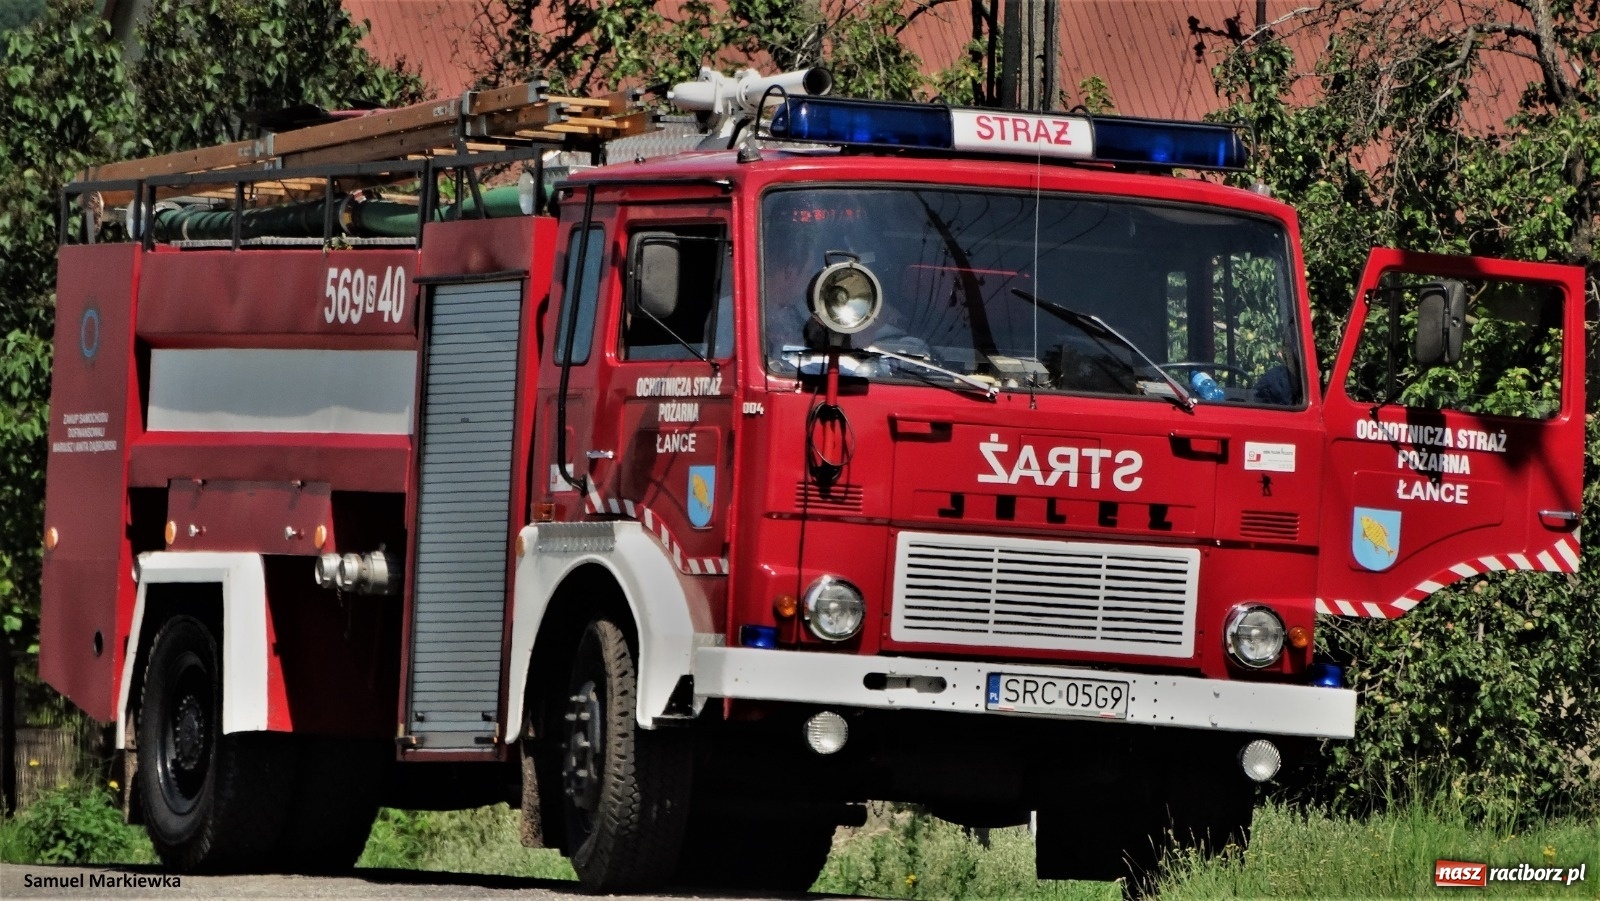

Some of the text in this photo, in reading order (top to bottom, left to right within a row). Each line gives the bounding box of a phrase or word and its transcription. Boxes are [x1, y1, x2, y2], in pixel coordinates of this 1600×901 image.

[636, 372, 723, 398] OCHOTNICZA STRAŻ
[658, 399, 699, 423] POŻARNA
[742, 402, 764, 415] 004
[656, 429, 697, 454] ŁAŃCE
[1356, 418, 1508, 453] OCHOTNICZA STRAŻ
[1397, 447, 1471, 475] POŻARNA
[1396, 478, 1470, 505] ŁAŃCE
[989, 678, 1123, 710] PL SRC 05G9
